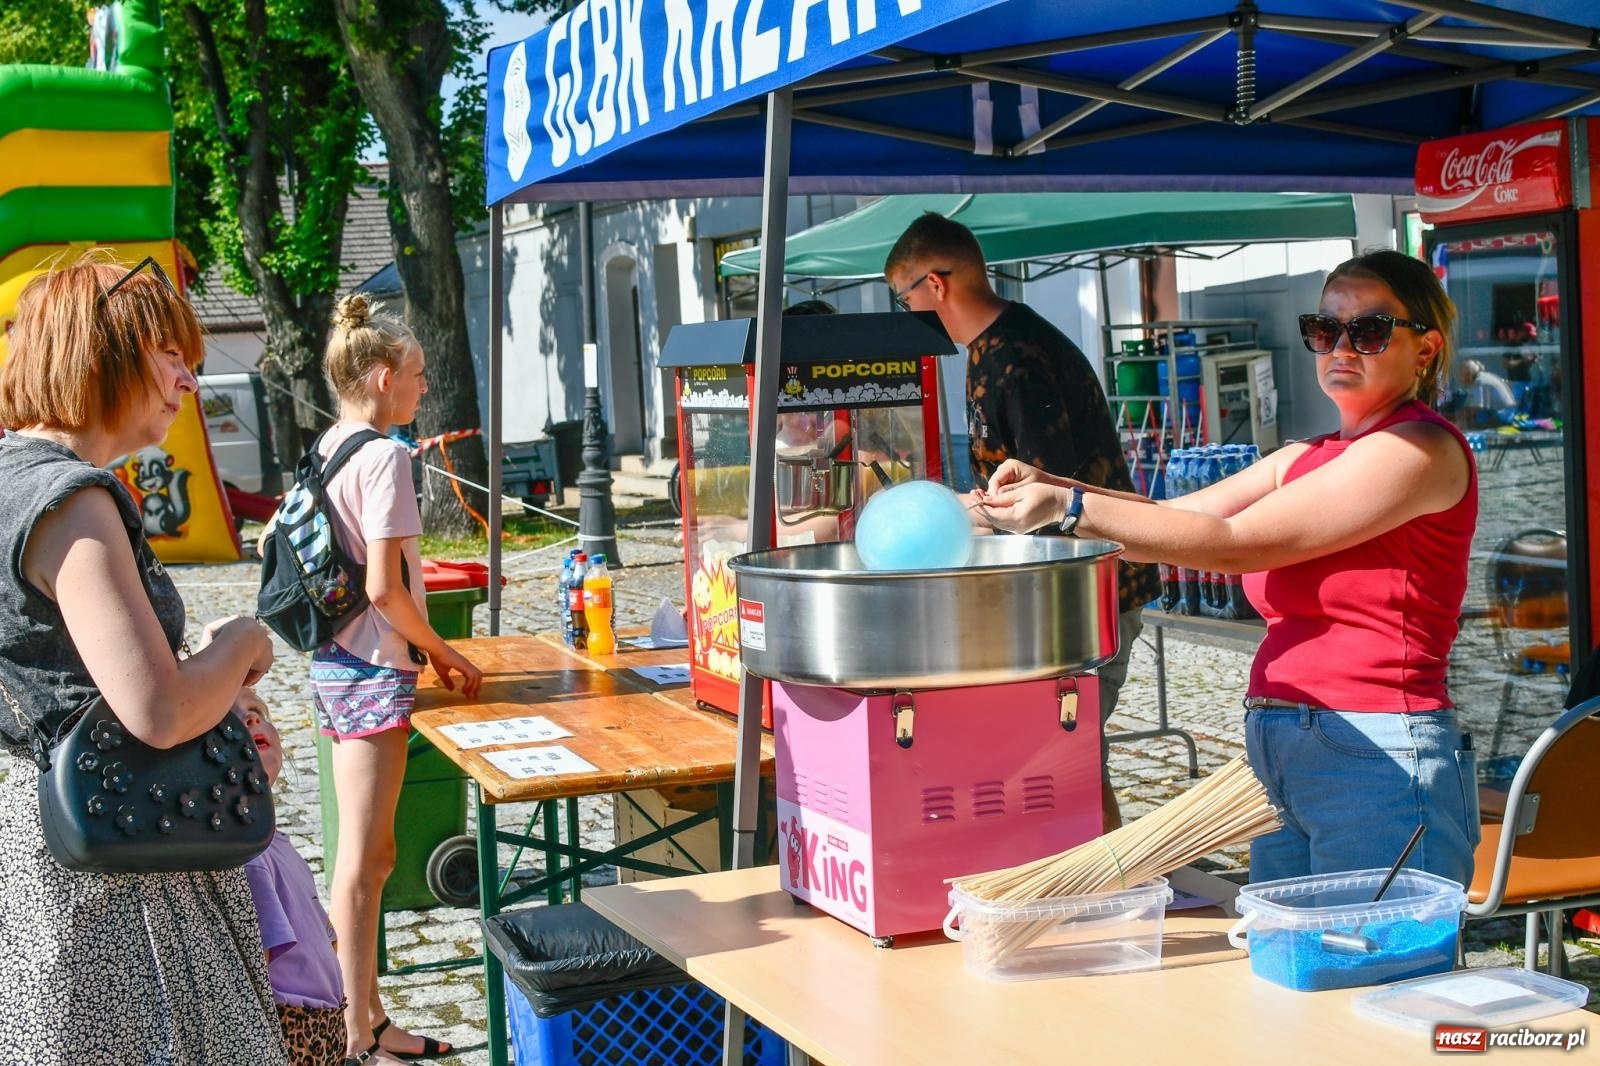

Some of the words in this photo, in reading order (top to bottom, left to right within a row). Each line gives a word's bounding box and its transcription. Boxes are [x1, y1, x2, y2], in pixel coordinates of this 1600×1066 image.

[1441, 138, 1516, 190] Coca-Cola
[693, 366, 727, 382] POPCORN
[811, 360, 917, 379] POPCORN
[746, 607, 762, 617] DANGER
